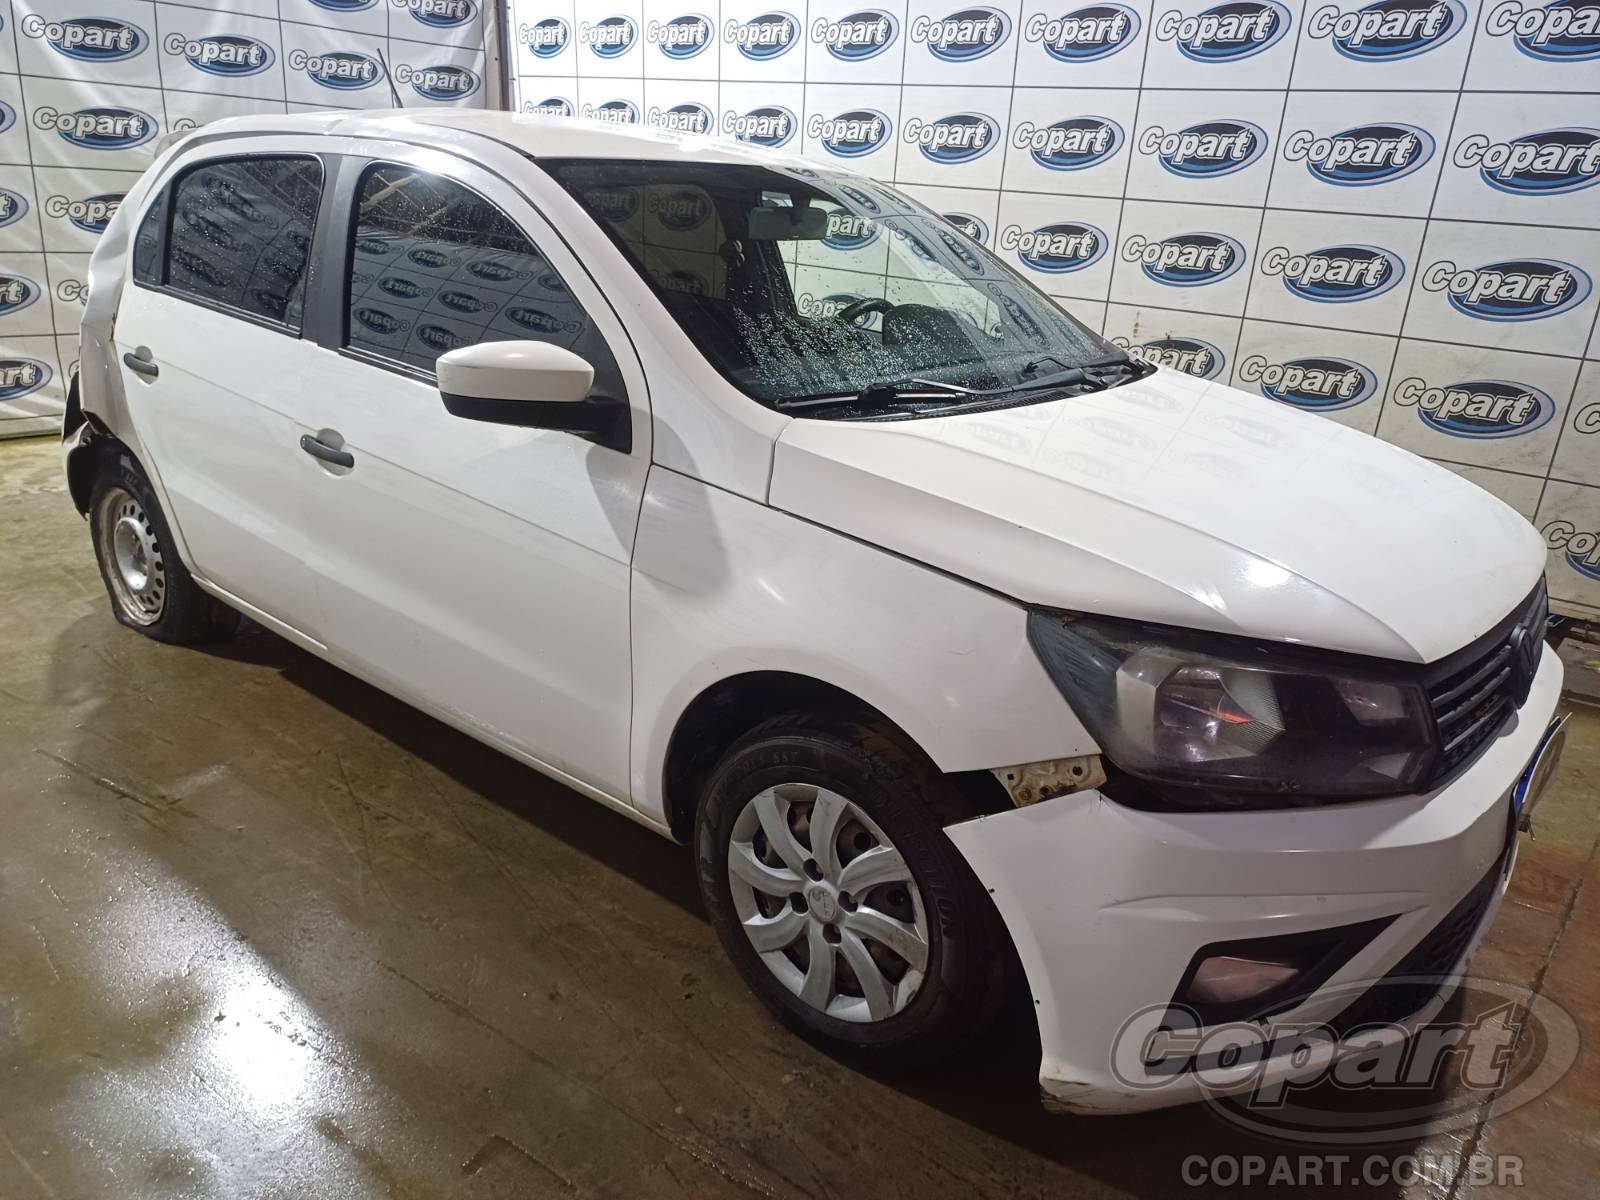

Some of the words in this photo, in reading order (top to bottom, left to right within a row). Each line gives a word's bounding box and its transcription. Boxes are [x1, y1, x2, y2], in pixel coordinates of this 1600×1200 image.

[22, 15, 134, 52] Copart
[519, 16, 565, 48] Copart
[579, 16, 631, 49] Copart
[647, 16, 706, 50] Copart
[723, 17, 792, 51] Copart
[811, 15, 889, 51] Copart
[911, 14, 1000, 50] Copart
[1024, 12, 1127, 50] Copart
[1156, 8, 1275, 51] Copart
[1308, 1, 1449, 47] Copart
[1486, 1, 1600, 46] Copa
[164, 33, 262, 66] Copart
[289, 50, 374, 80] Copart
[395, 64, 470, 91] Copart
[33, 106, 145, 139] Copart
[722, 112, 790, 146] Copart
[807, 114, 884, 150] Copart
[903, 118, 989, 152] Copart
[1013, 121, 1110, 158] Copart
[1139, 126, 1252, 164] Copart
[1284, 131, 1418, 171] Copart
[1453, 134, 1600, 179] Copart
[826, 213, 875, 239] part
[1001, 225, 1097, 260] Copart
[1122, 234, 1232, 273] Copart
[1261, 247, 1390, 287] Copart
[1422, 259, 1572, 304] Copart
[1239, 355, 1362, 399] Copart
[1394, 377, 1540, 426] Copart
